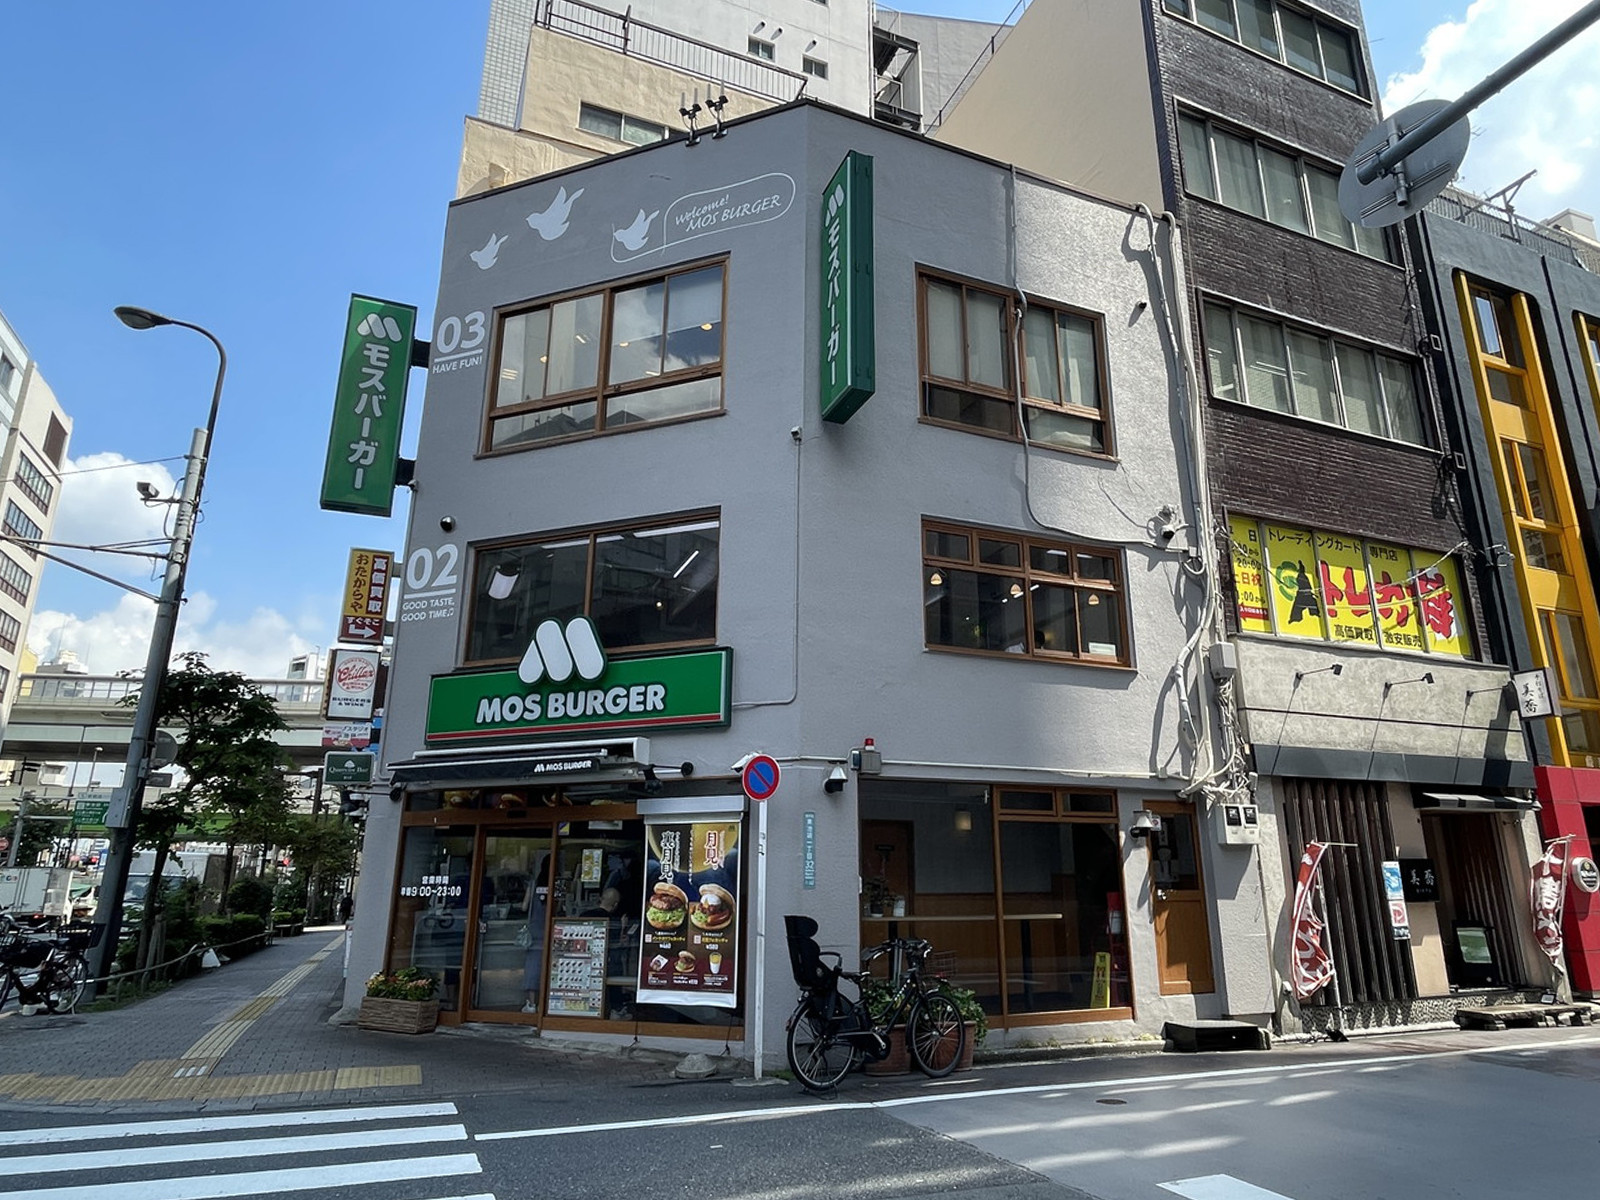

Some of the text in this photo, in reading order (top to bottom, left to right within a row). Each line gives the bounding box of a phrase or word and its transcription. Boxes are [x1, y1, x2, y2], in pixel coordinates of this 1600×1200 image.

[686, 194, 782, 232] MOS BURGER
[827, 217, 841, 385] モスバーガー
[436, 311, 486, 354] 03
[432, 356, 483, 375] HAVE FUN!
[348, 342, 390, 490] モスバーガー
[350, 553, 369, 613] おたからや
[406, 543, 459, 590] 02
[401, 611, 426, 622] GOOD
[402, 600, 428, 611] GOOD
[475, 684, 666, 724] MOS BURGER
[546, 760, 592, 771] MOS BURGER
